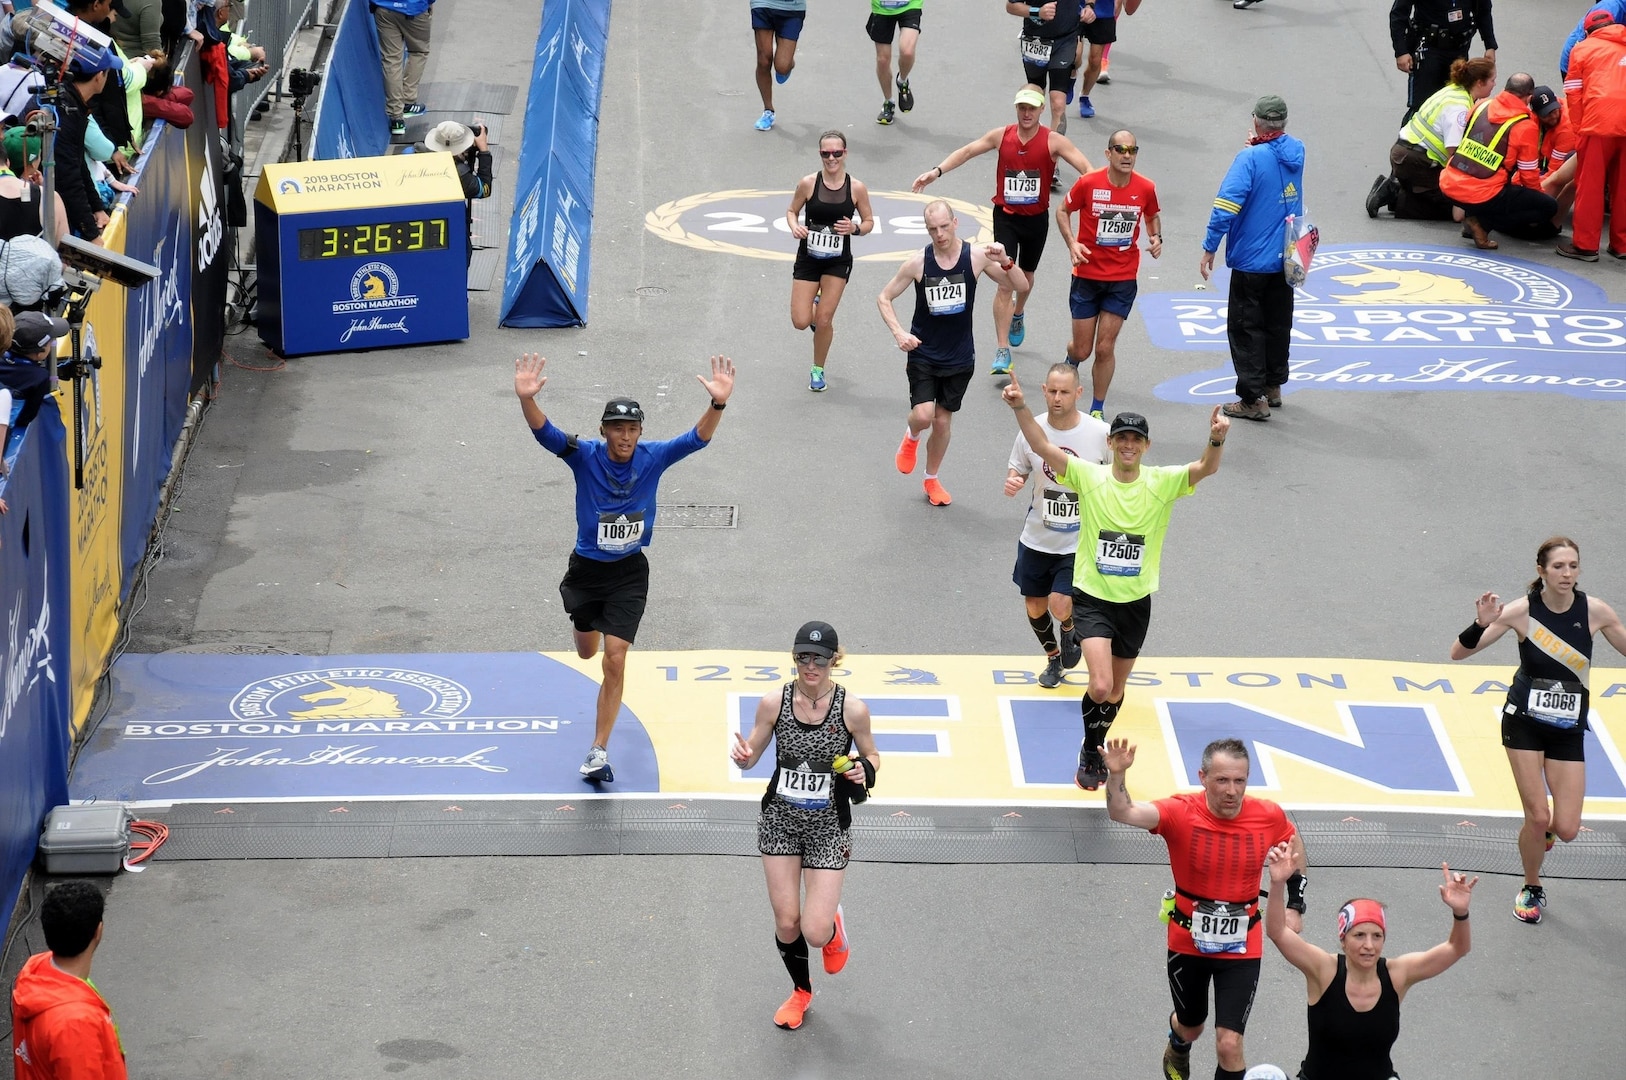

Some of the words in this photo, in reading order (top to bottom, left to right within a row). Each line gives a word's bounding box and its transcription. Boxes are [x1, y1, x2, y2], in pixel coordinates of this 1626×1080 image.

[1464, 142, 1499, 167] PHYSICIAN
[303, 174, 329, 185] 2019
[330, 170, 379, 183] BOSTON
[306, 180, 382, 194] MARATHON
[1008, 178, 1037, 192] 11739
[1102, 220, 1133, 234] 12580
[198, 207, 222, 273] adidas
[321, 219, 446, 257] 3:26:37
[811, 231, 841, 249] 11118
[1431, 254, 1561, 305] ASSOCIATION
[929, 284, 963, 302] 11224
[332, 302, 367, 312] BOSTON
[369, 297, 418, 309] MARATHON
[1171, 304, 1337, 325] 29
[1354, 309, 1626, 331] BOSTO
[339, 318, 367, 343] John
[367, 315, 410, 334] Hancock
[602, 522, 640, 539] 10874
[1102, 541, 1141, 561] 12505
[1533, 627, 1588, 672] BOSTON
[239, 686, 275, 718] BOSTON
[269, 668, 382, 690] ATHLETIC
[387, 670, 464, 716] ASSOCIATION
[1536, 691, 1577, 712] 13068
[123, 723, 302, 736] BOSTON
[141, 747, 291, 785] John
[308, 744, 509, 774] Hancock
[785, 770, 826, 792] 12137
[1201, 915, 1239, 936] 8120
